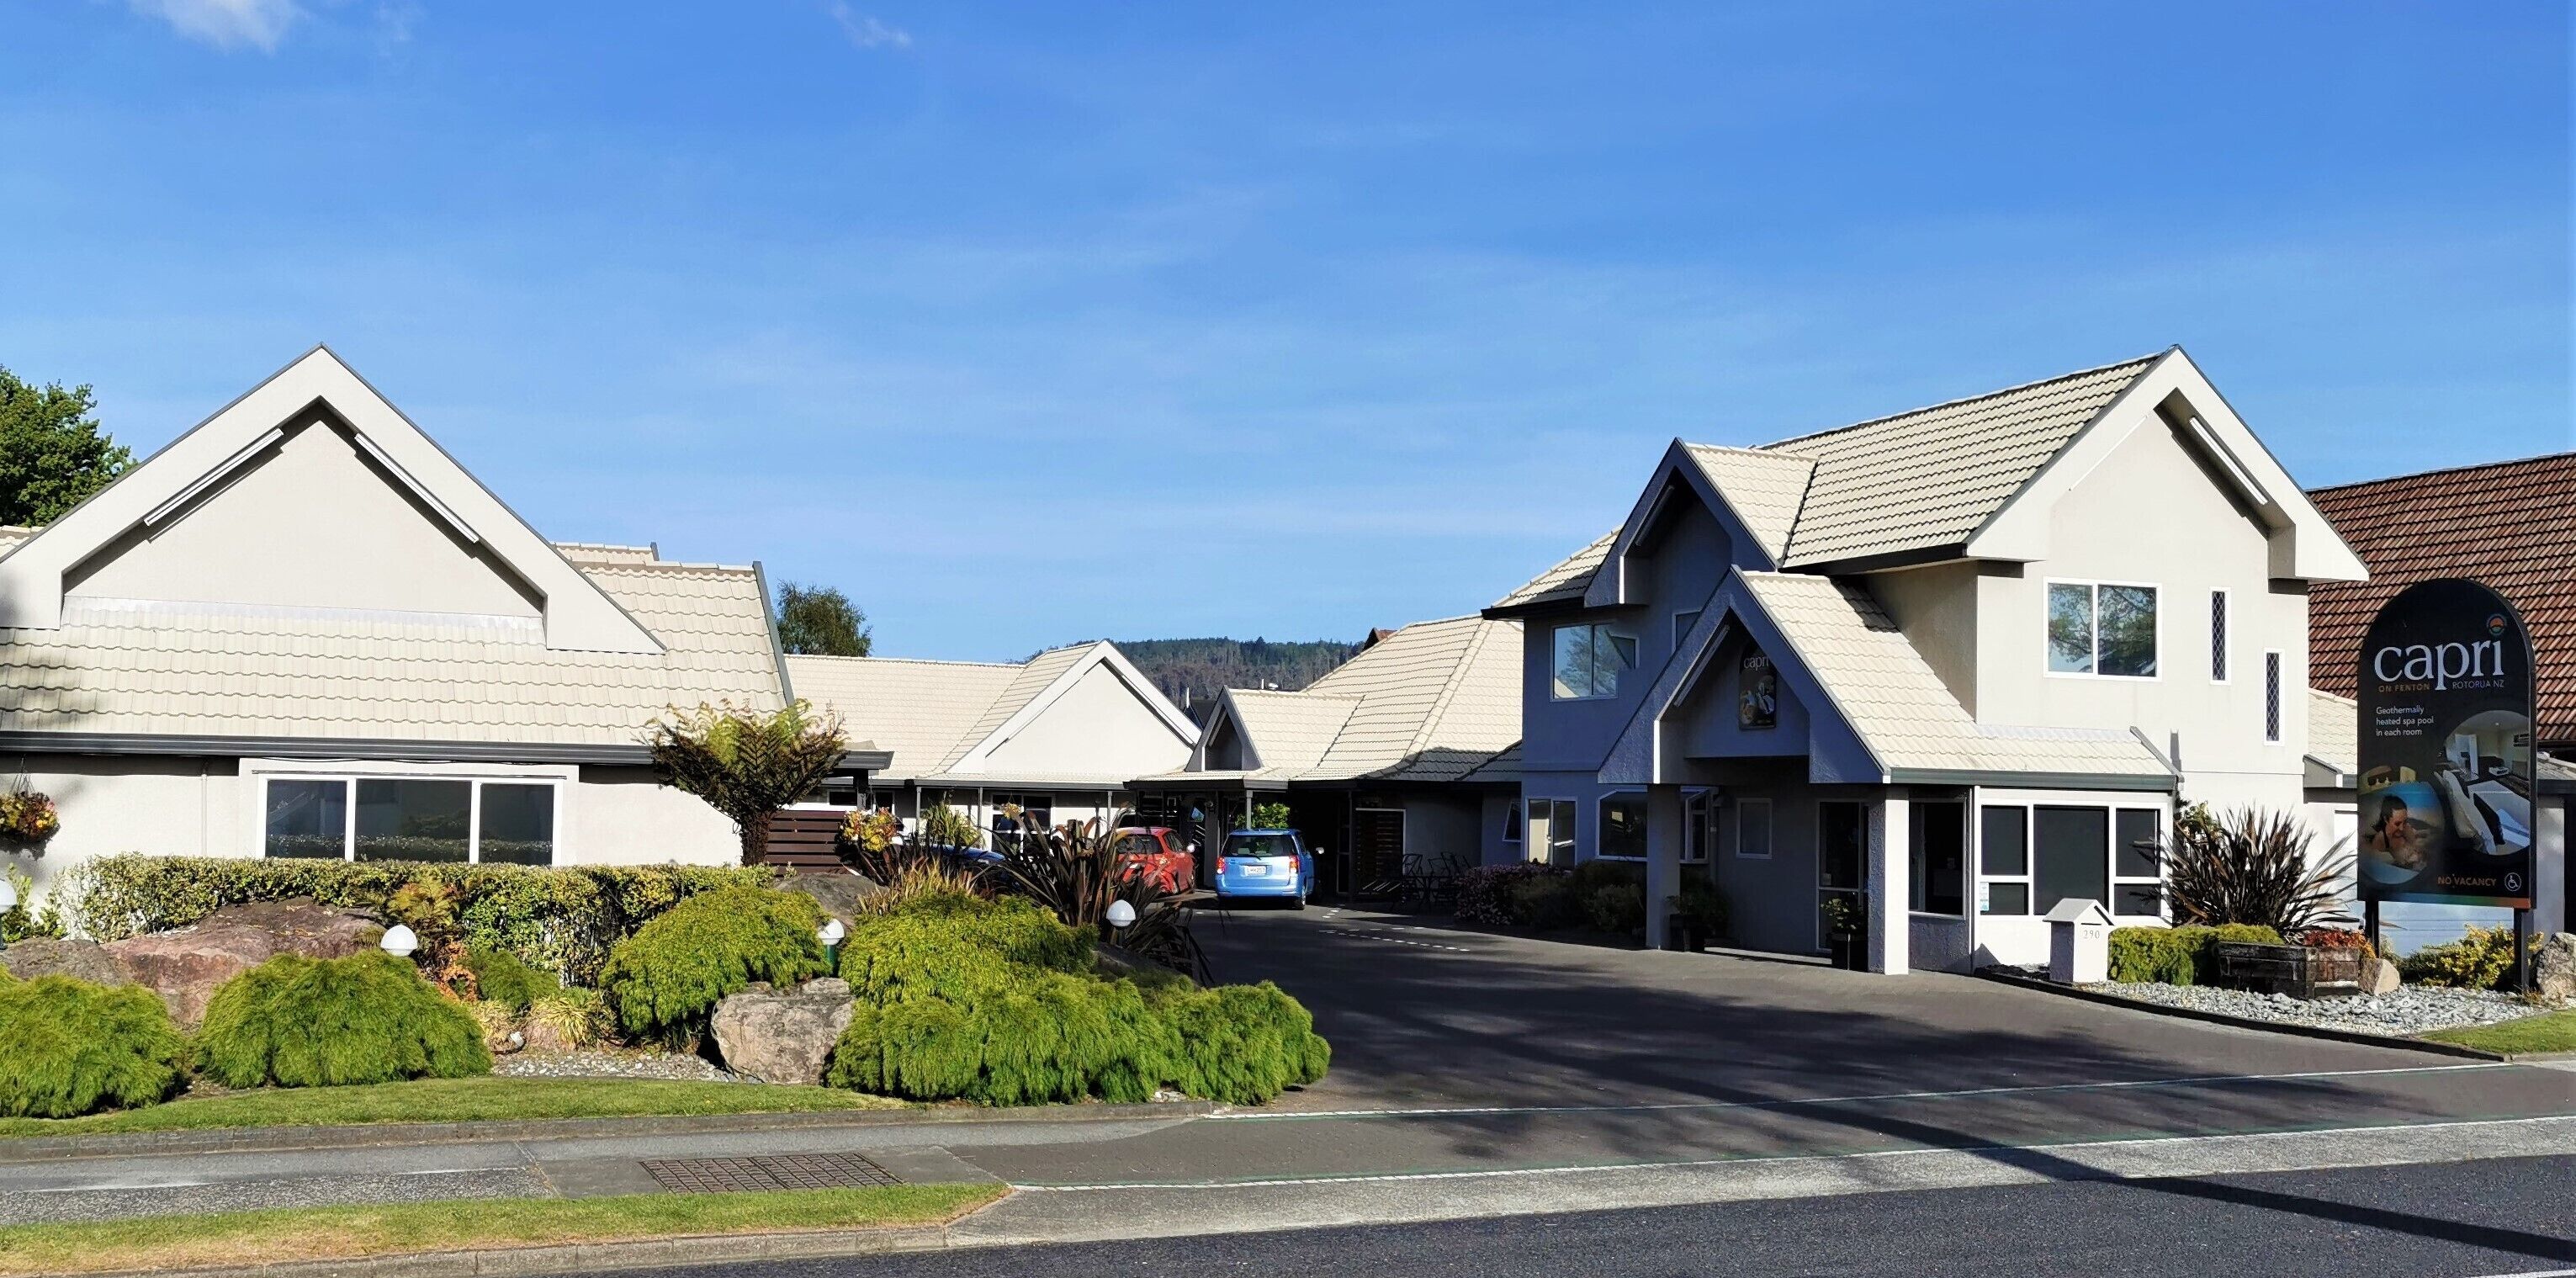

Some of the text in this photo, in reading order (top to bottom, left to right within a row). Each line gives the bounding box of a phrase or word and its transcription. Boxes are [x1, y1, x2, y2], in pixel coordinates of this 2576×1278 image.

[1743, 656, 1769, 671] capri
[2374, 640, 2504, 690] capri
[2394, 683, 2430, 692] FENTON
[2452, 679, 2504, 689] ROTORUA NZ
[2376, 704, 2425, 715] Geothermally
[2376, 716, 2434, 727] heated spa pool
[2384, 728, 2401, 736] each
[2437, 876, 2497, 886] NO VACANCY
[2082, 929, 2101, 939] 290
